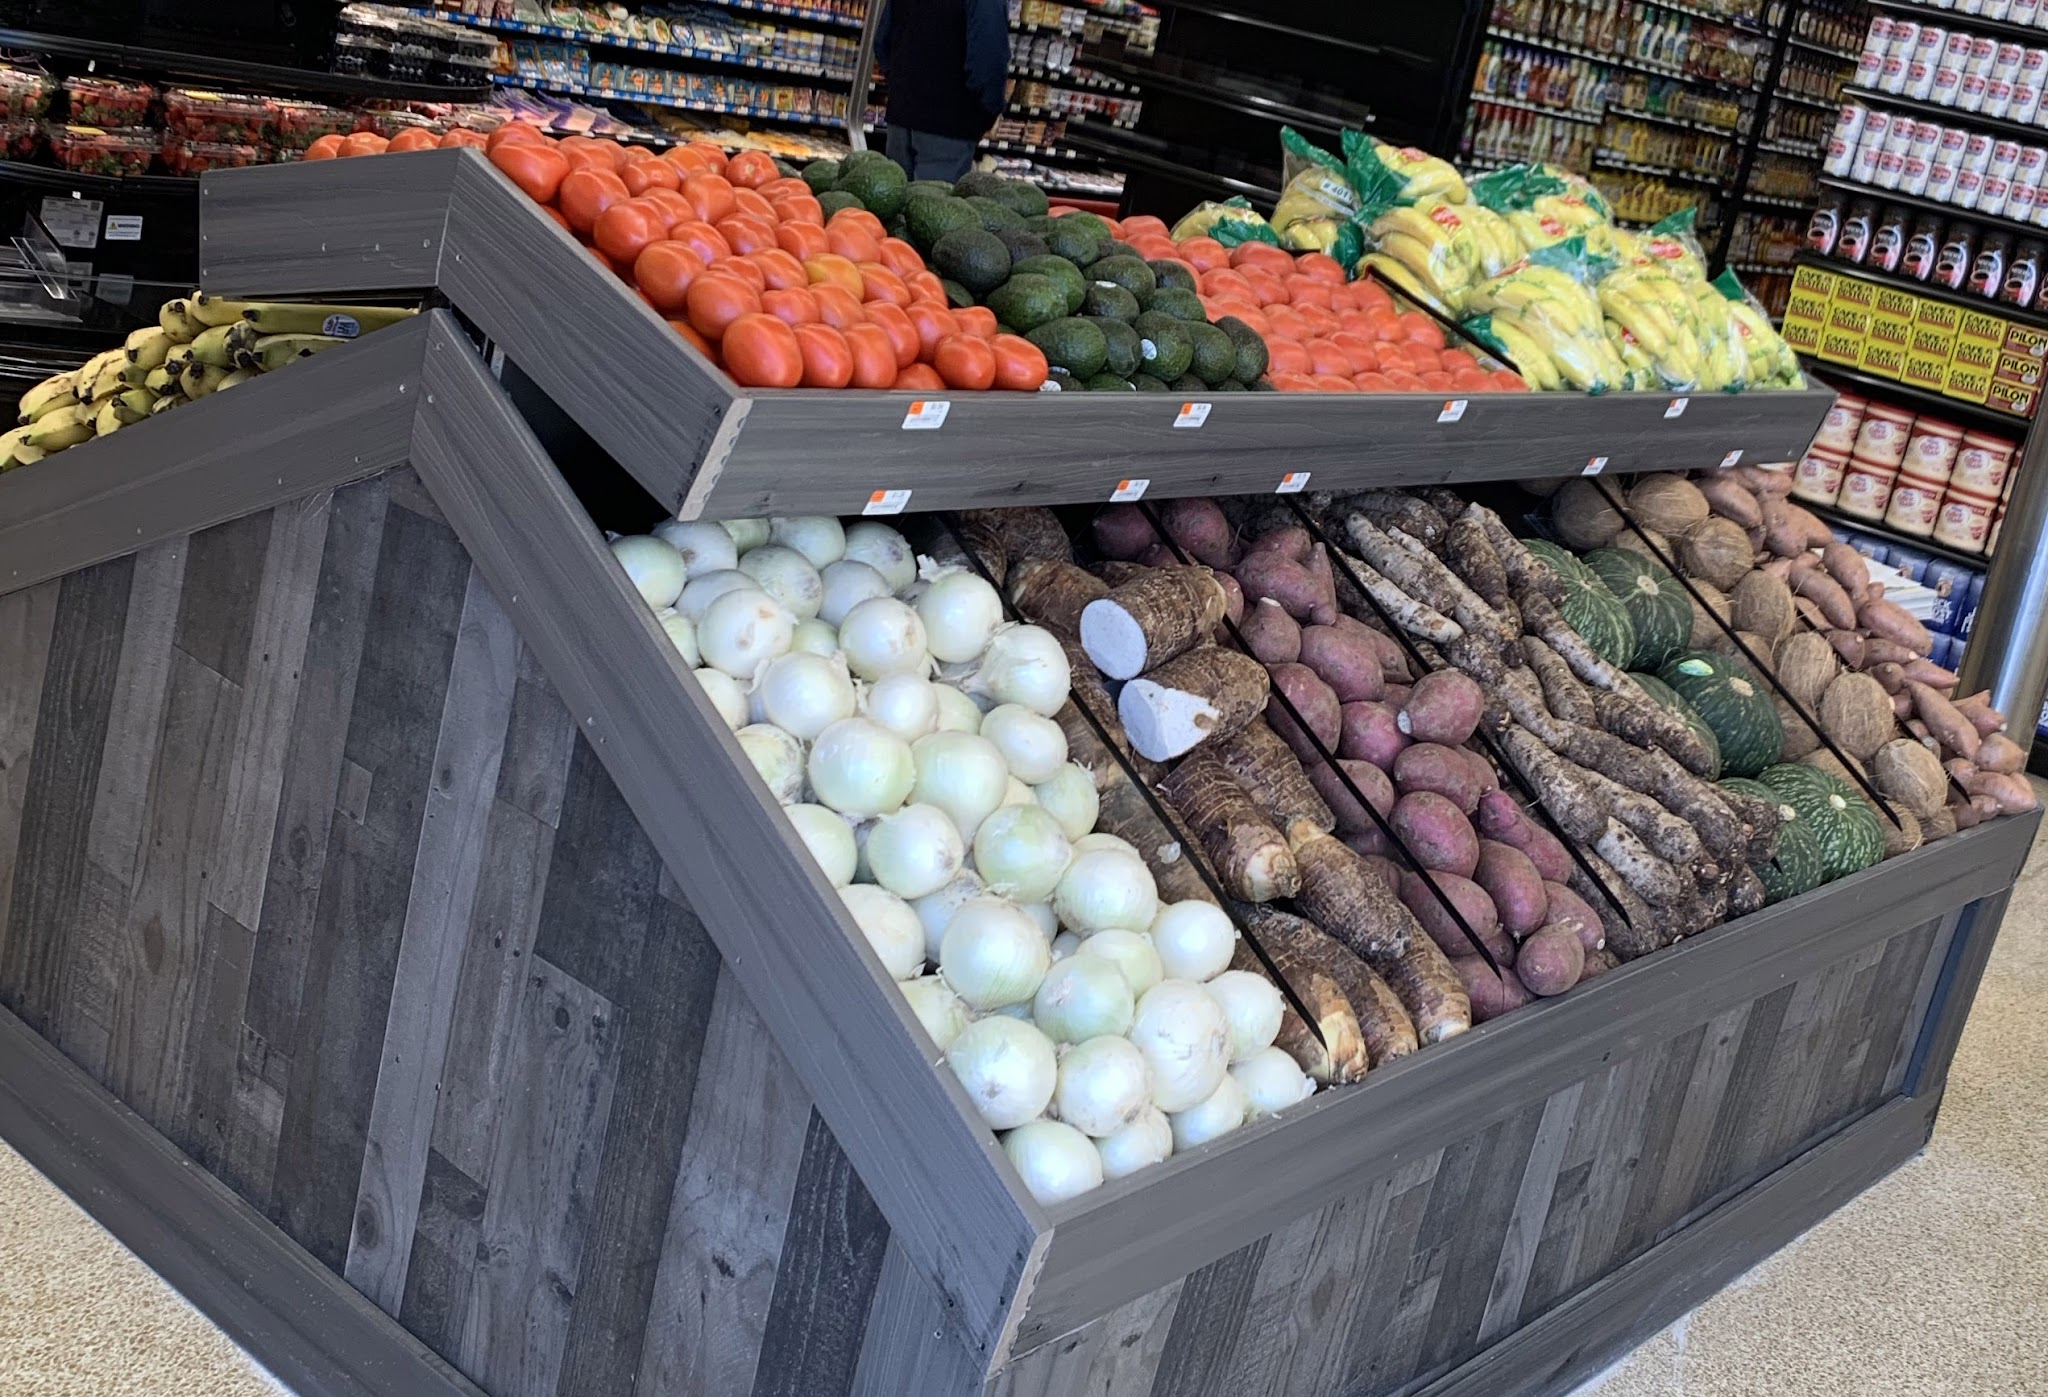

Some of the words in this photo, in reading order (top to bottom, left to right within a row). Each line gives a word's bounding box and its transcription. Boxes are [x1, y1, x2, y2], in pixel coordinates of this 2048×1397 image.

[2011, 331, 2047, 348] PILON
[2002, 357, 2039, 374] PILON
[1993, 384, 2029, 402] PILON
